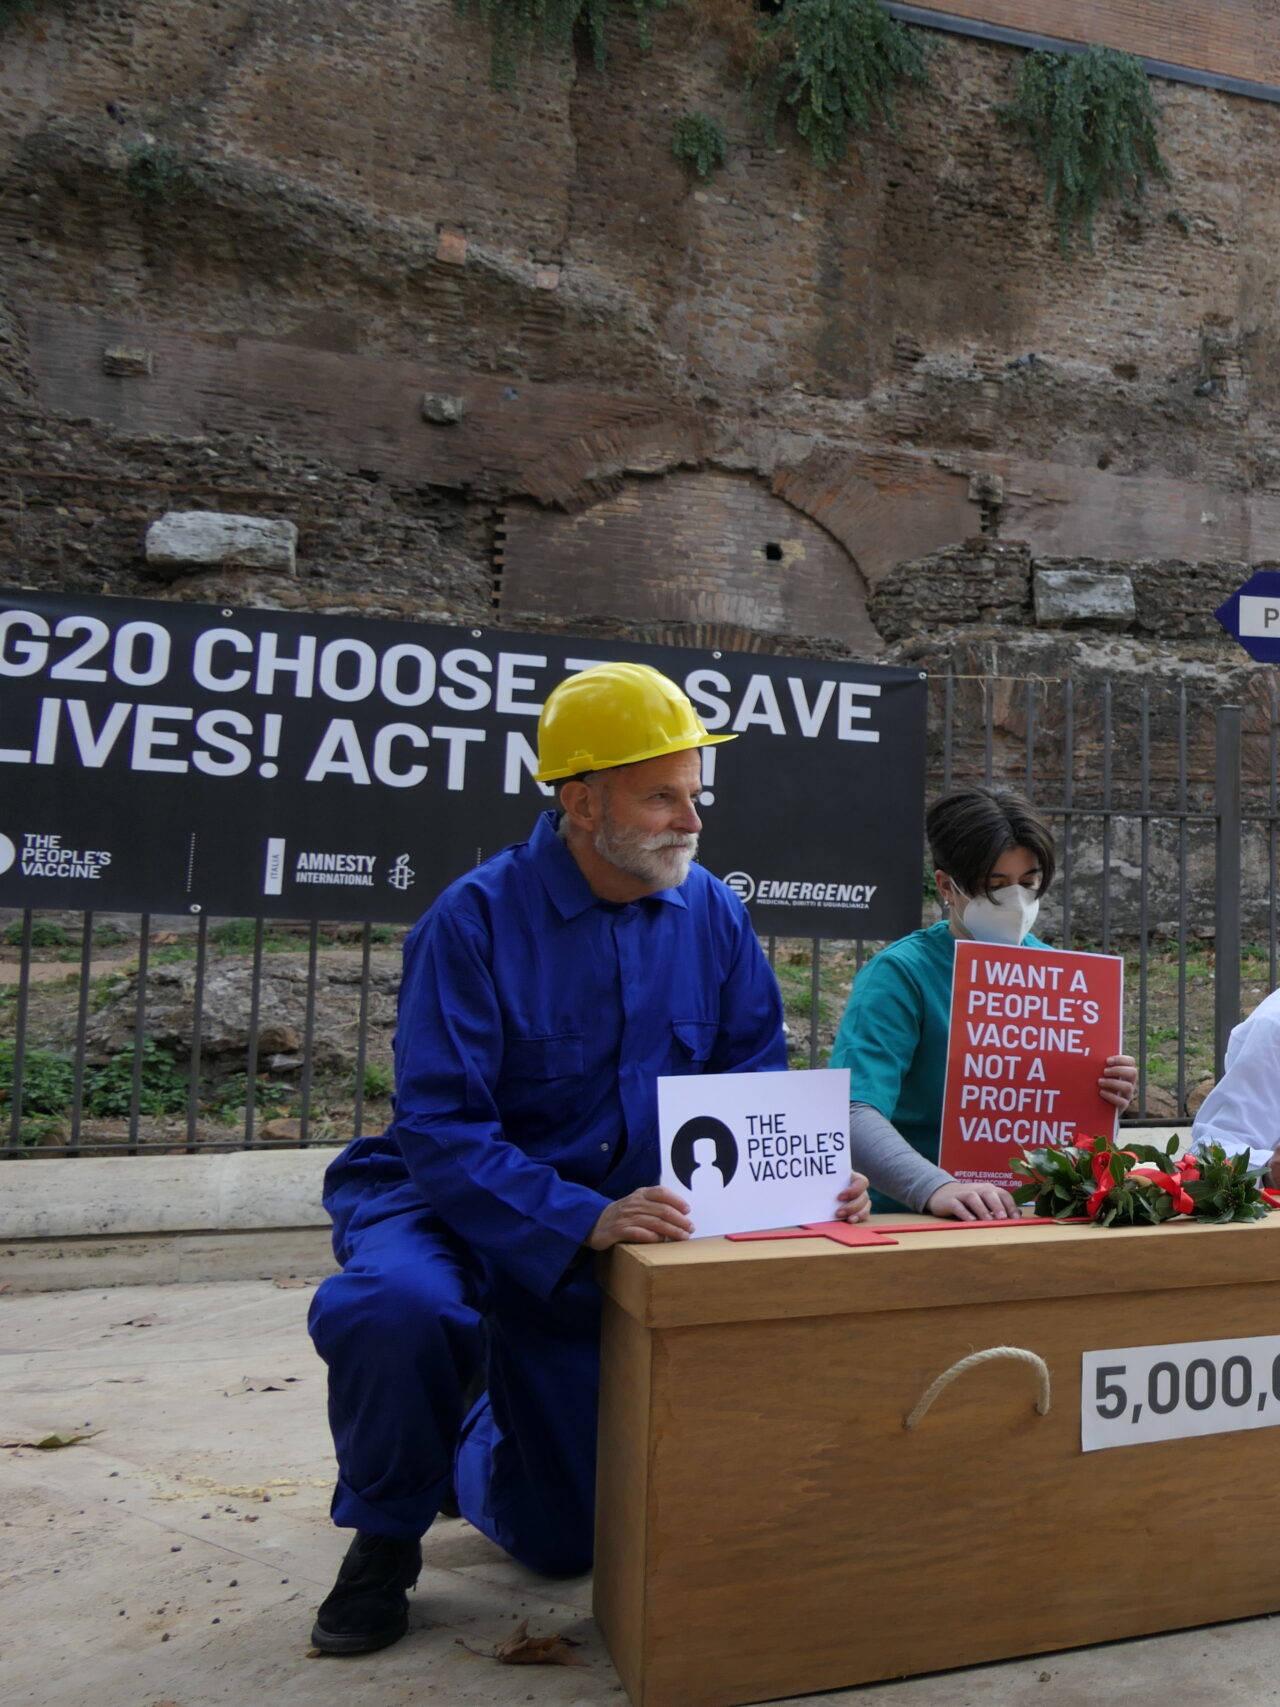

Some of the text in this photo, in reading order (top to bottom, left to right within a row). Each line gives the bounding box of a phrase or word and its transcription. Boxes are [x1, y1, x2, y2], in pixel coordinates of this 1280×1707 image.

[0, 610, 881, 743] G20 CHOOSE SAVE
[305, 718, 486, 791] ACT
[504, 730, 717, 807] N!
[24, 834, 62, 849] THE
[22, 848, 112, 865] PEOPLE'S
[270, 854, 280, 880] ITALIA
[297, 852, 376, 873] AMNESTY
[21, 862, 102, 879] VACCINE
[296, 872, 374, 886] INTERNATIONAL
[757, 880, 877, 902] EMERGENCY
[970, 959, 1088, 993] I WANT A
[967, 990, 1099, 1024] PEOPLE'S
[966, 1021, 1090, 1057] VACCINE,
[964, 1053, 1046, 1082] NOT A
[961, 1085, 1060, 1113] PROFIT
[745, 1113, 786, 1136] THE
[959, 1117, 1077, 1145] VACCINE
[747, 1132, 845, 1159] PEOPLE'S
[749, 1155, 837, 1182] VACCINE
